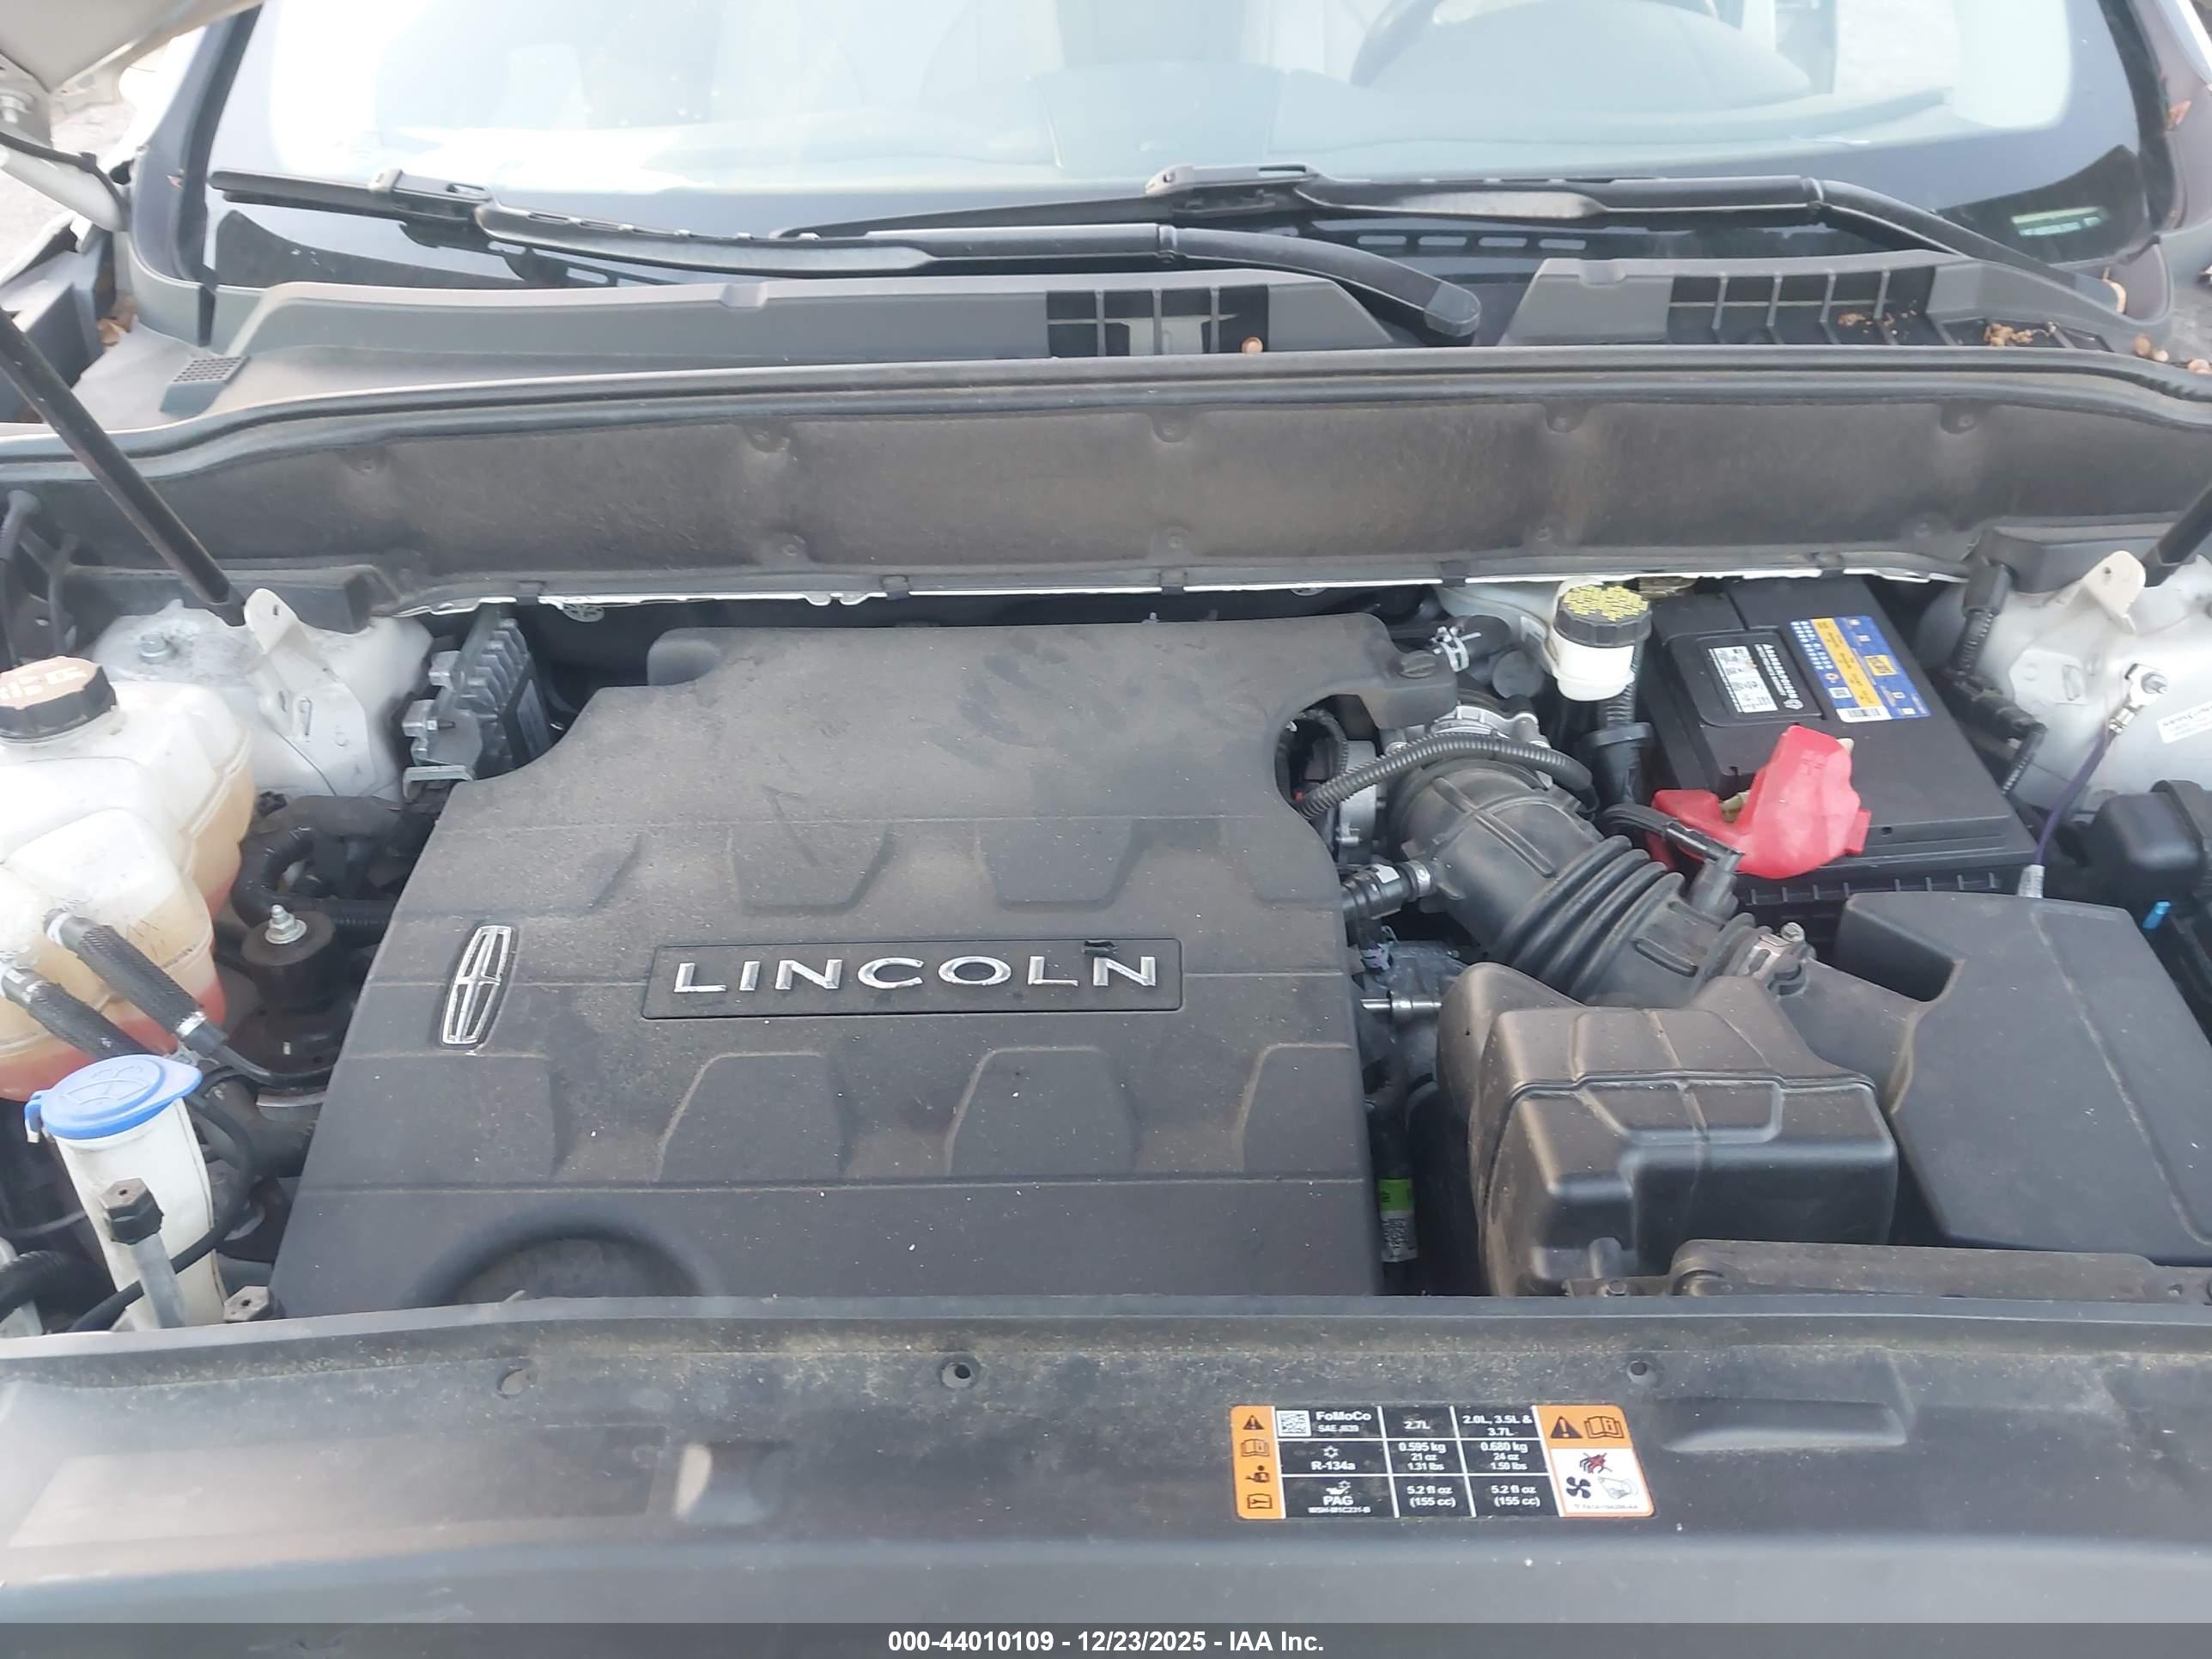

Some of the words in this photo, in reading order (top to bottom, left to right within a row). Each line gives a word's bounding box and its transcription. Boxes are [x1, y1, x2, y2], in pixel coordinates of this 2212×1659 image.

[673, 955, 1158, 993] LINCOLN
[1316, 1411, 1372, 1421] FoMoCo
[1494, 1415, 1521, 1424] 3.5L
[1522, 1415, 1533, 1424] &
[1404, 1420, 1431, 1430] 2.7L
[1487, 1427, 1515, 1436] 3.7L
[1398, 1442, 1430, 1451] 0.595
[1431, 1443, 1446, 1454] kg
[1512, 1442, 1528, 1453] kg
[1310, 1461, 1356, 1471] R-134a
[1407, 1486, 1425, 1494] 5.2
[1425, 1486, 1436, 1494] fl
[1491, 1485, 1510, 1494] 5.2
[1510, 1485, 1520, 1493] fl
[1322, 1495, 1354, 1505] PAG
[1409, 1497, 1436, 1508] (155
[1437, 1497, 1456, 1508] cc)
[1494, 1496, 1520, 1507] (155
[1522, 1497, 1540, 1507] cc)
